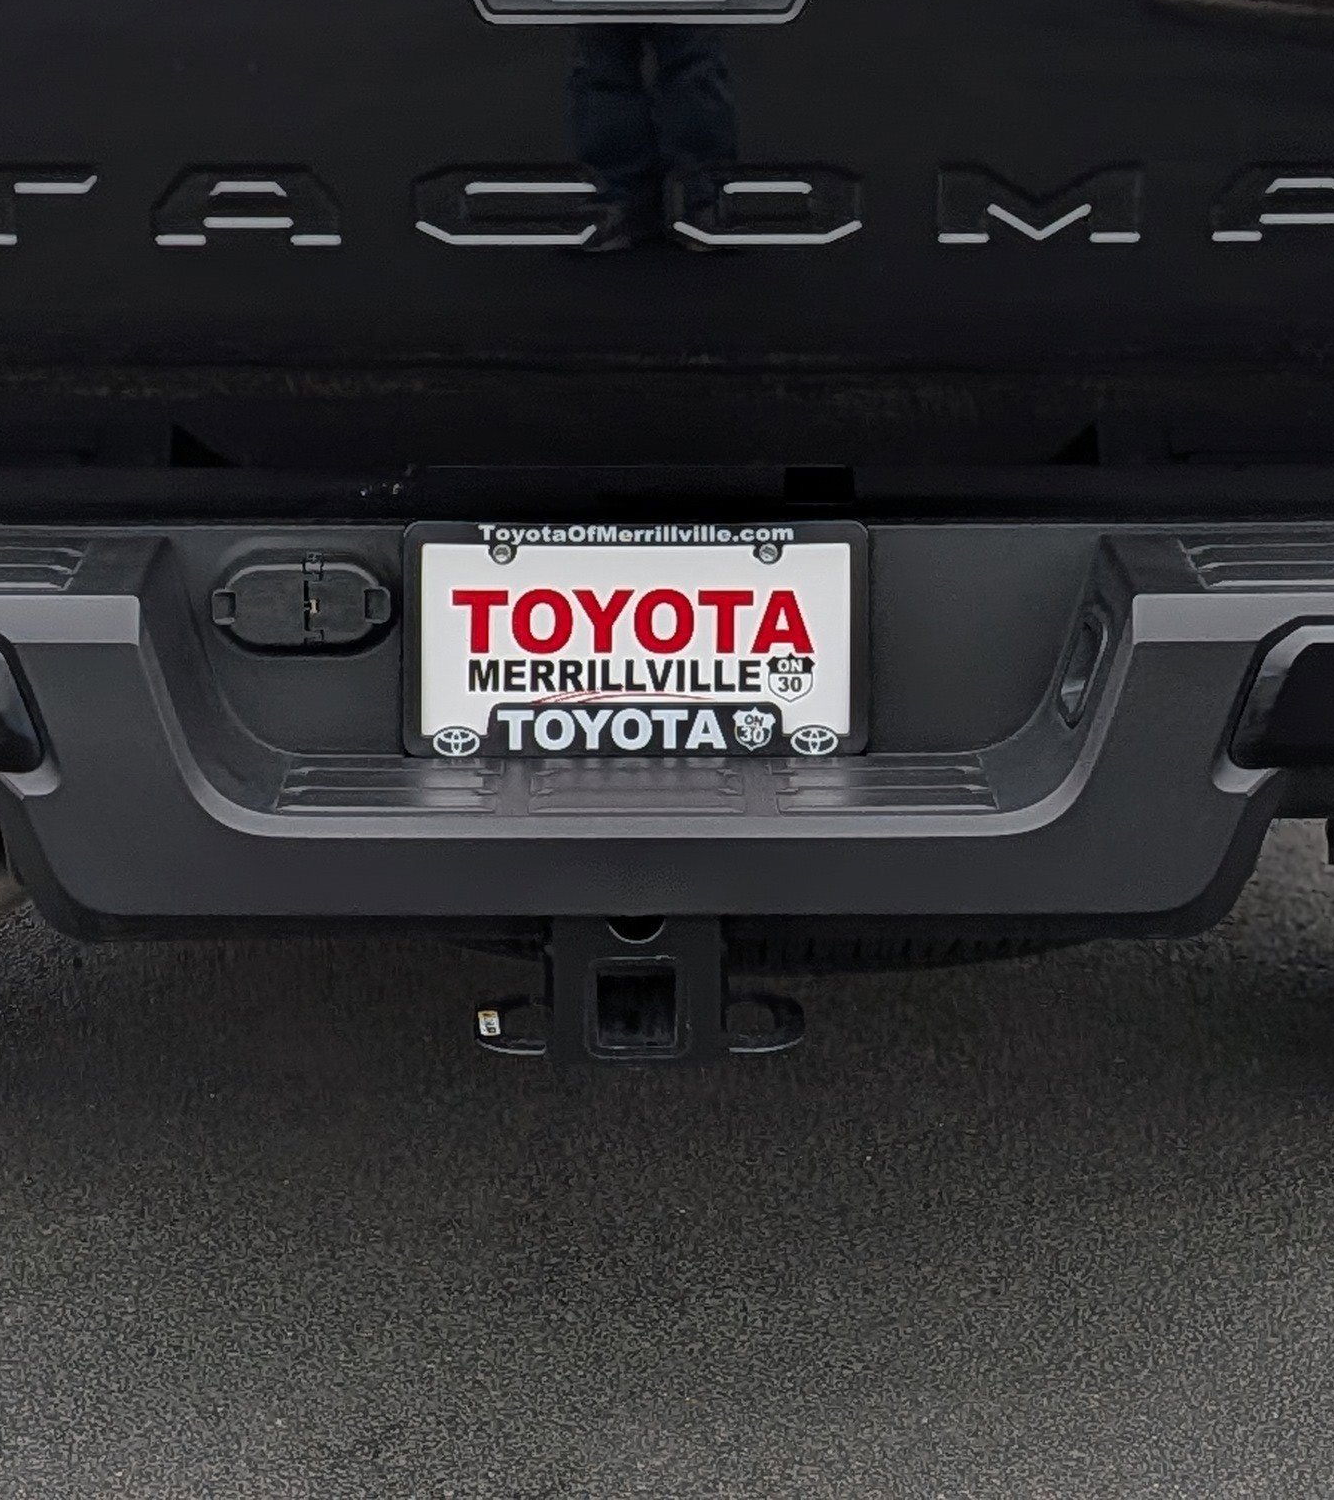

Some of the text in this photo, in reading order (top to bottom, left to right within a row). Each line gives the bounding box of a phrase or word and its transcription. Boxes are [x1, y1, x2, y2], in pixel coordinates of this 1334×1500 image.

[478, 524, 795, 545] ToyotaOfMerrillville.com
[452, 589, 814, 654] TOYOTA
[776, 659, 803, 672] ON
[468, 660, 761, 693] MERRILLVILLE
[777, 676, 803, 693] 30
[744, 713, 764, 726] ON
[497, 709, 727, 752] TOYOTA
[739, 725, 764, 743] 30
